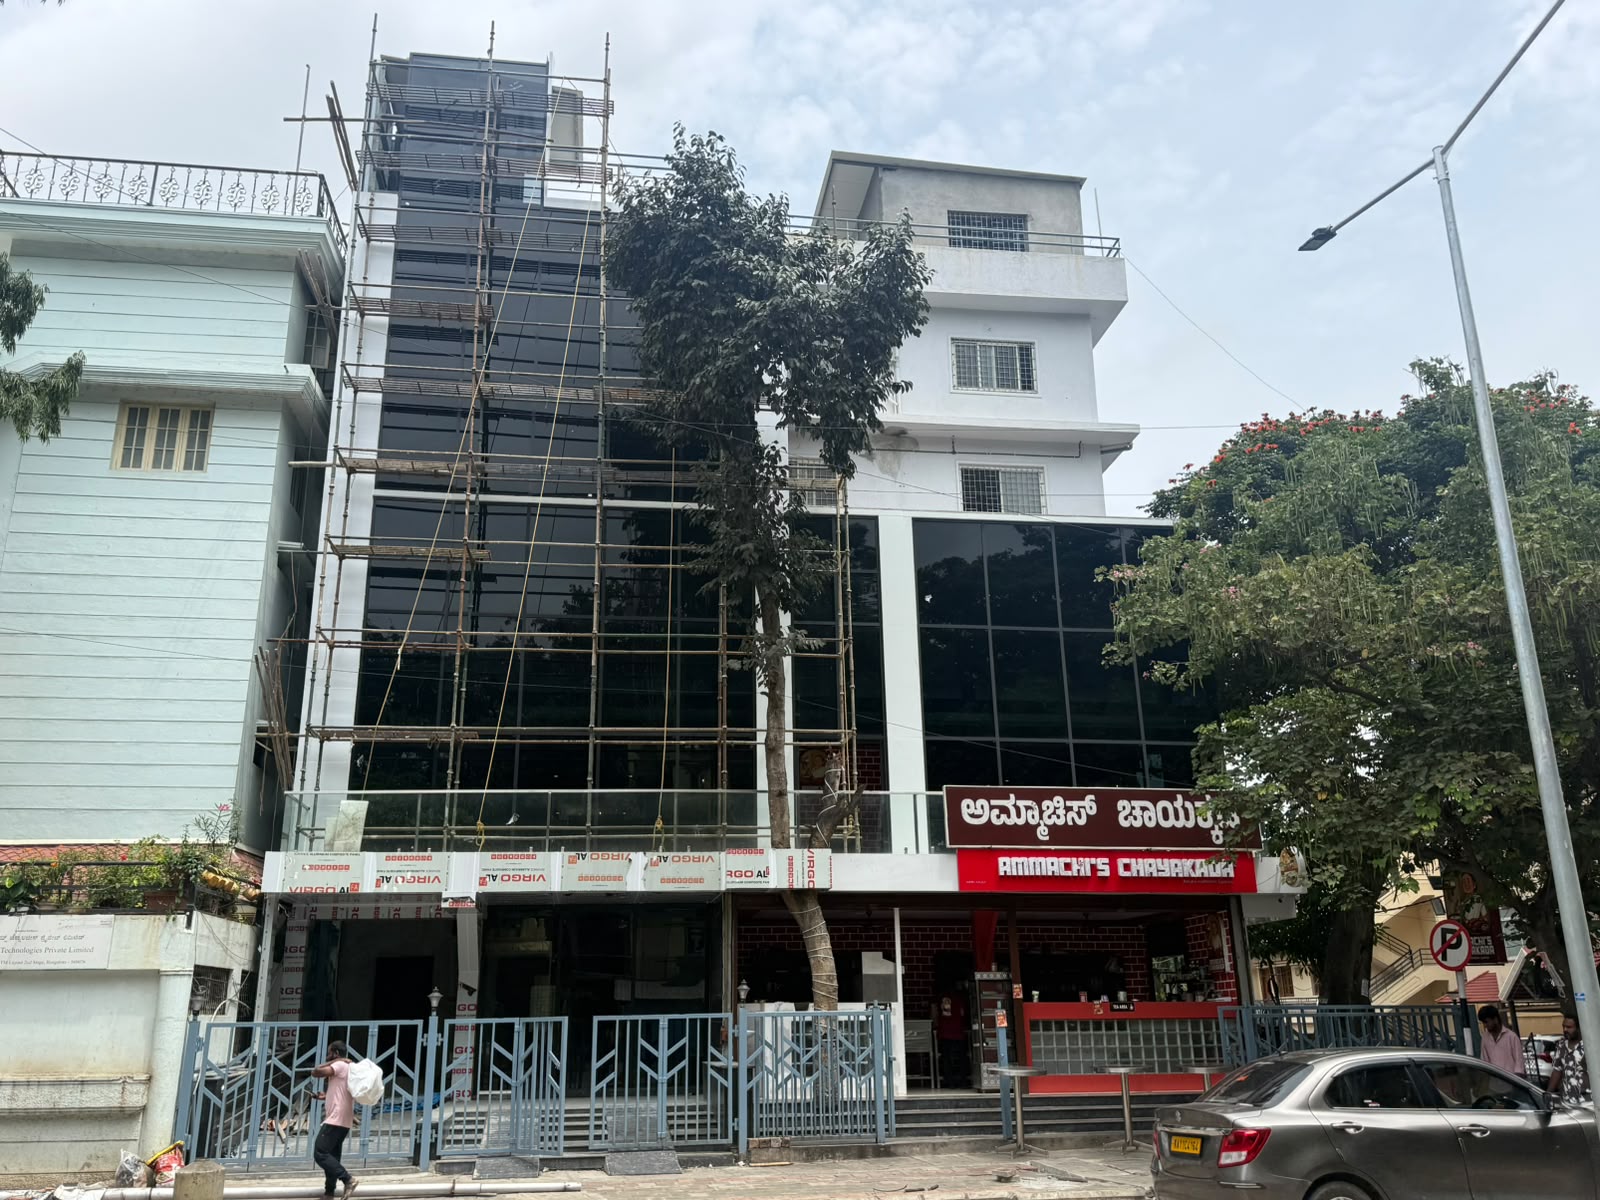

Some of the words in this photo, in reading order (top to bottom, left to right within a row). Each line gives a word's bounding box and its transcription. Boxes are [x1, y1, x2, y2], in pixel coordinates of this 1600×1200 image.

[671, 855, 715, 863] VIRGO
[997, 856, 1110, 877] AMMACHI'S
[1117, 857, 1235, 878] CHAYAKADA
[394, 875, 442, 884] VIRGO
[500, 873, 547, 882] VIRGO
[1, 947, 42, 955] Technologies
[68, 946, 94, 954] Limited
